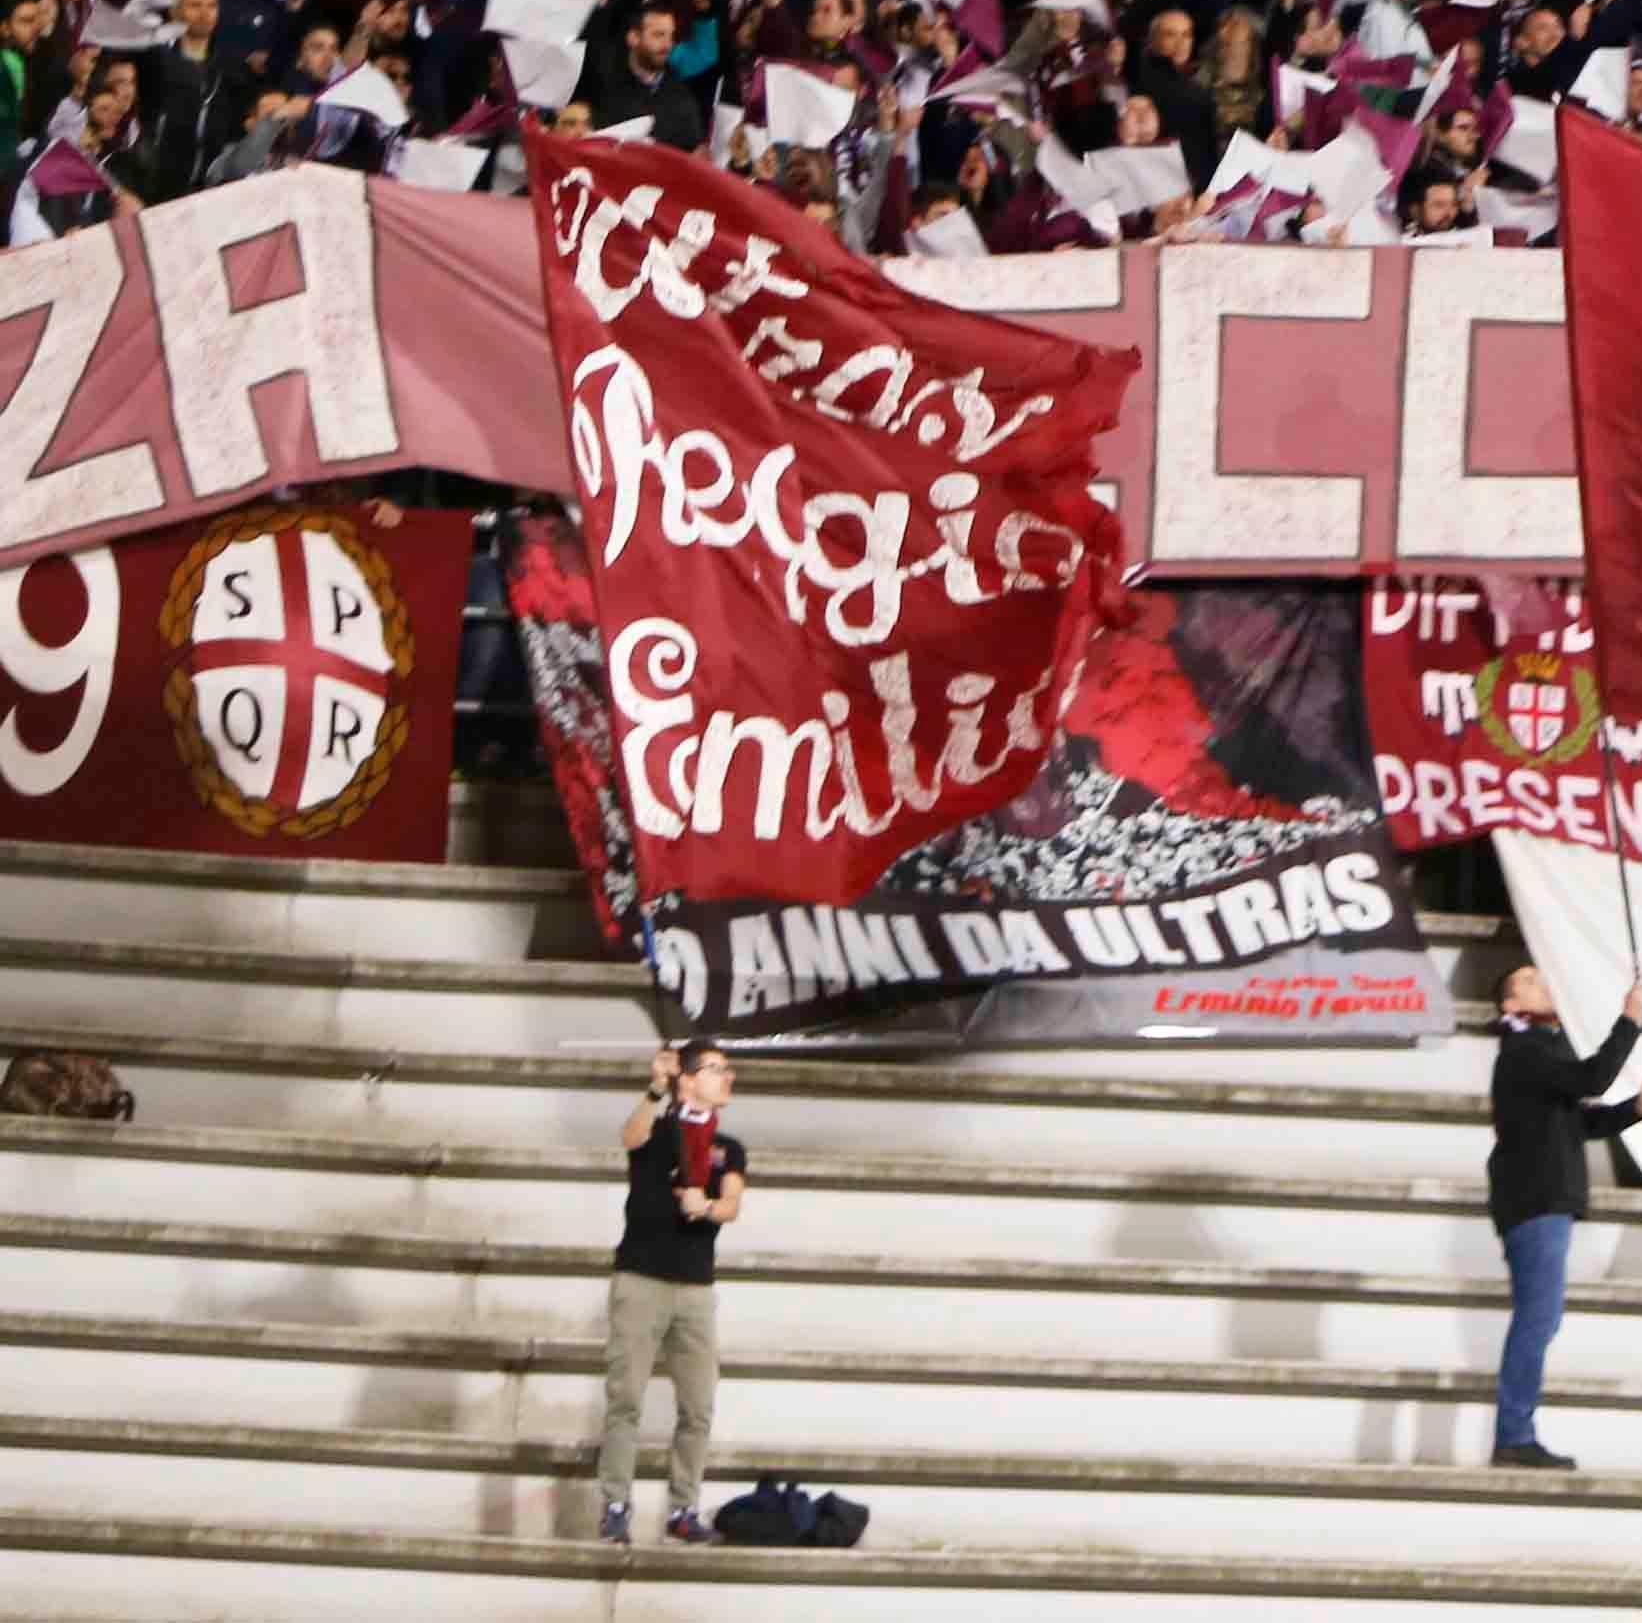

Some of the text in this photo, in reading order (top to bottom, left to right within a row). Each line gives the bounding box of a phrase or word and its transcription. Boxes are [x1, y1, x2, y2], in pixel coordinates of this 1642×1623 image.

[222, 569, 362, 636] S P
[219, 687, 362, 765] Q R
[728, 905, 940, 1019] ANNI
[943, 911, 1070, 977] DA
[1065, 849, 1394, 969] ULTRAS
